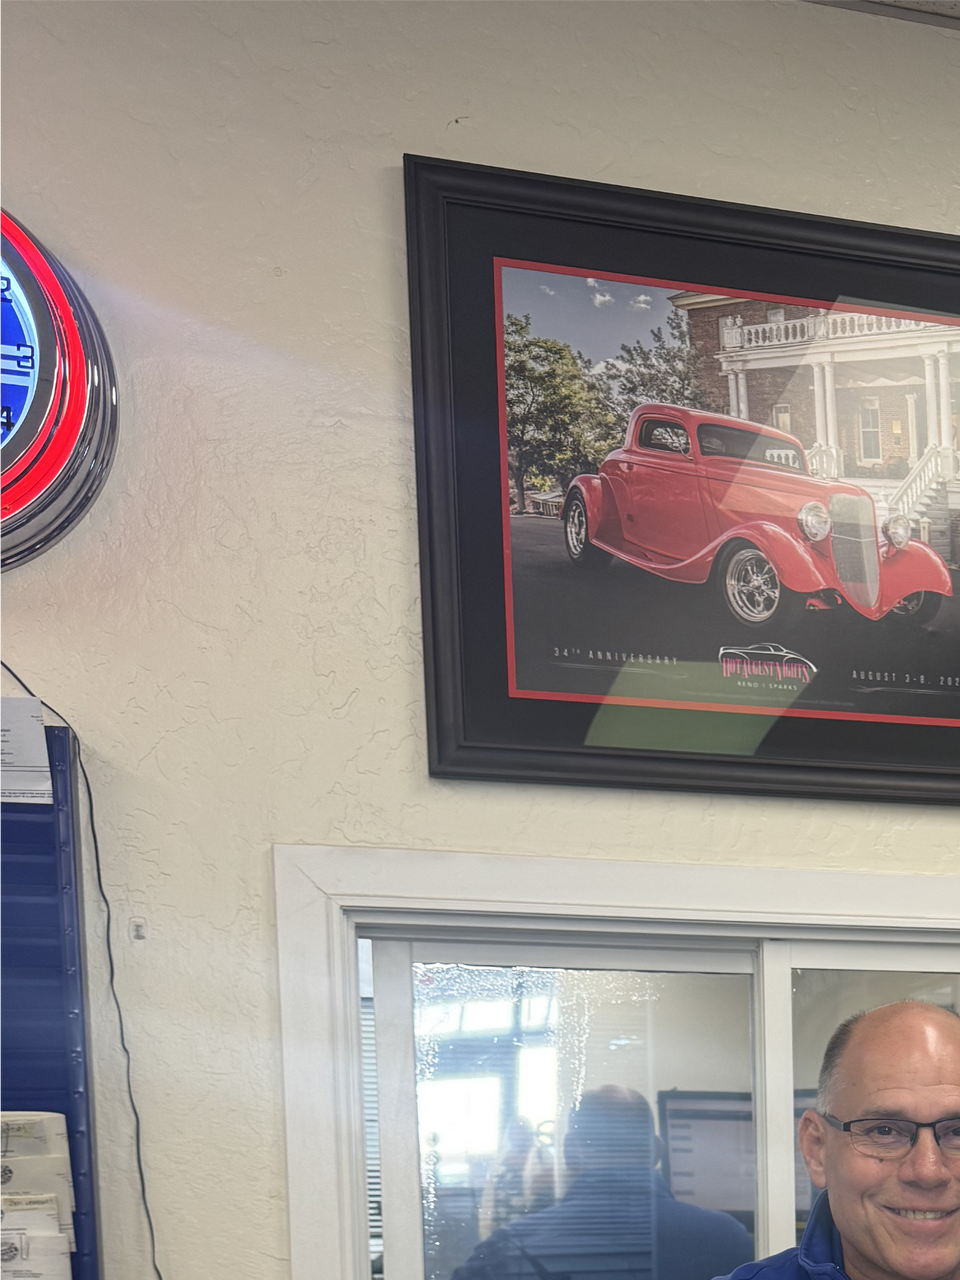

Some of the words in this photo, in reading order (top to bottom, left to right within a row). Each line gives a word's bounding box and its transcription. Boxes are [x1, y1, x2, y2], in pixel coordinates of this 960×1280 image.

[17, 344, 34, 370] 3
[588, 650, 678, 666] ANNIVERSARY
[852, 670, 896, 682] AUGUST
[769, 683, 798, 691] SPARKS
